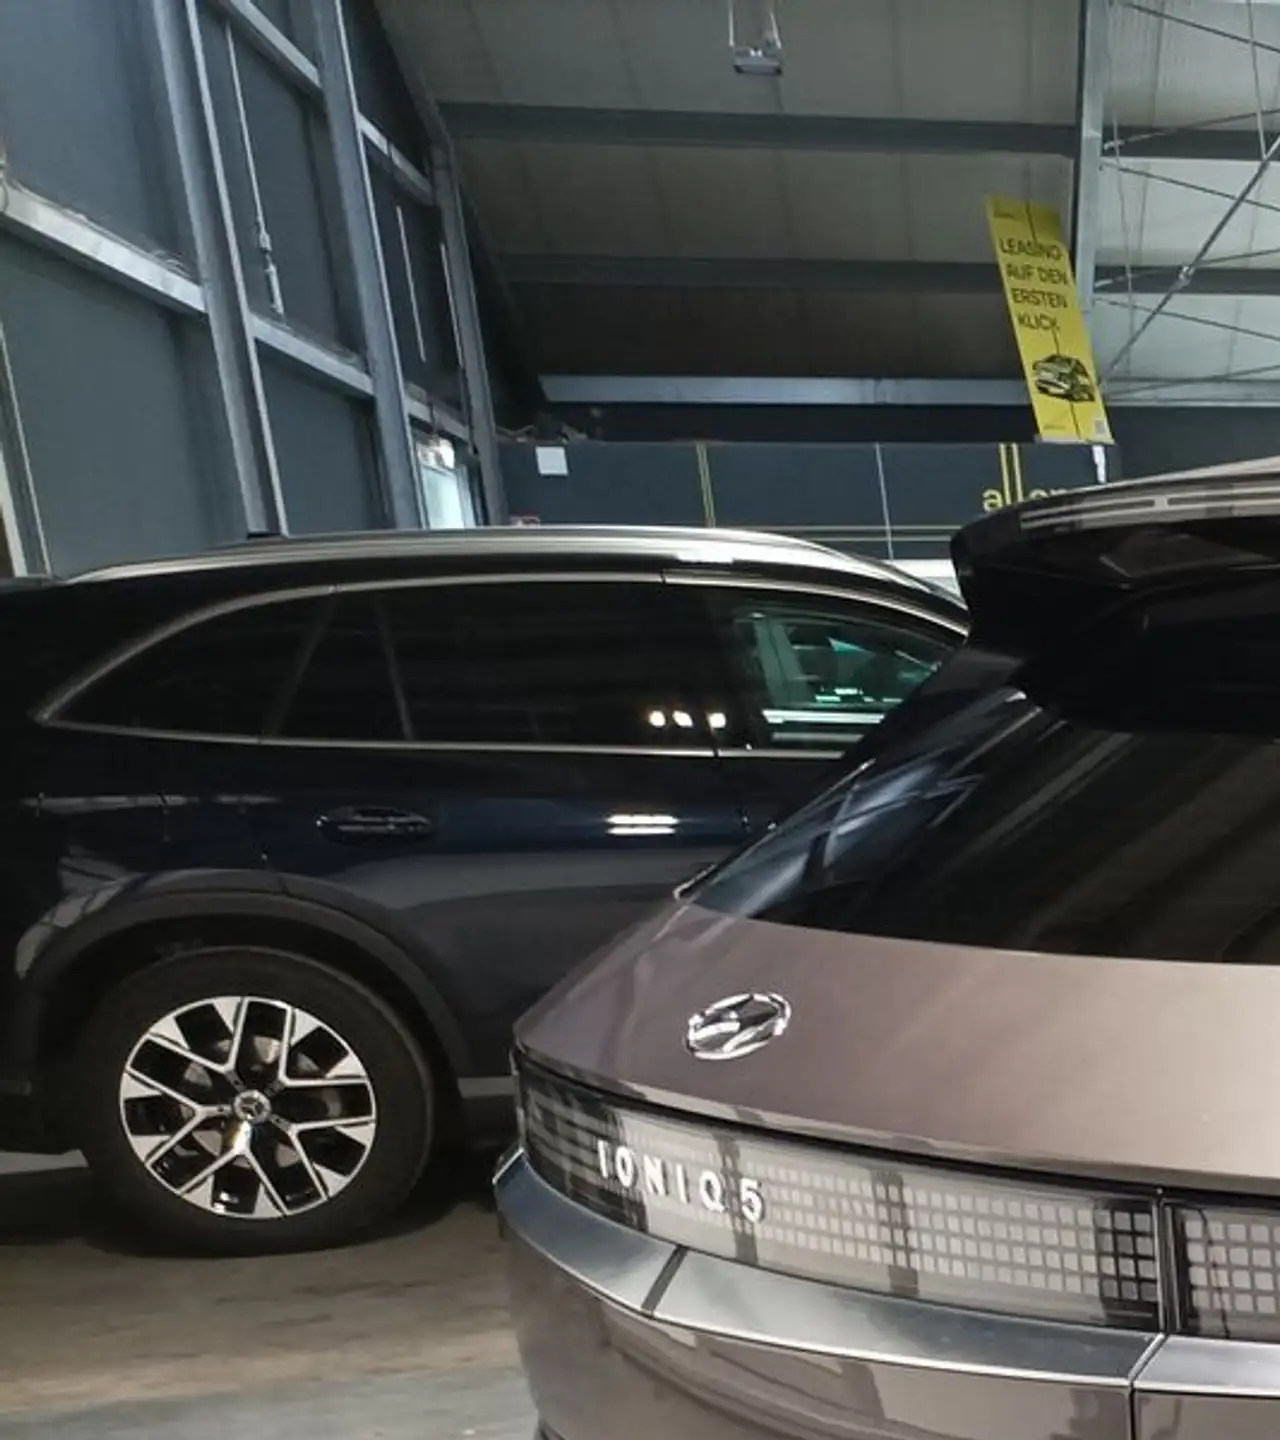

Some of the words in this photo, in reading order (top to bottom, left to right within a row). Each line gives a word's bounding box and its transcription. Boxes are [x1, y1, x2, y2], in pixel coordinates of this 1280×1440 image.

[998, 238, 1062, 261] LEASING
[1006, 263, 1034, 281] AUF
[1037, 266, 1068, 285] DEN
[1011, 287, 1068, 309] ERSTEN
[597, 1139, 726, 1214] IONIQ
[739, 1178, 764, 1223] 5
